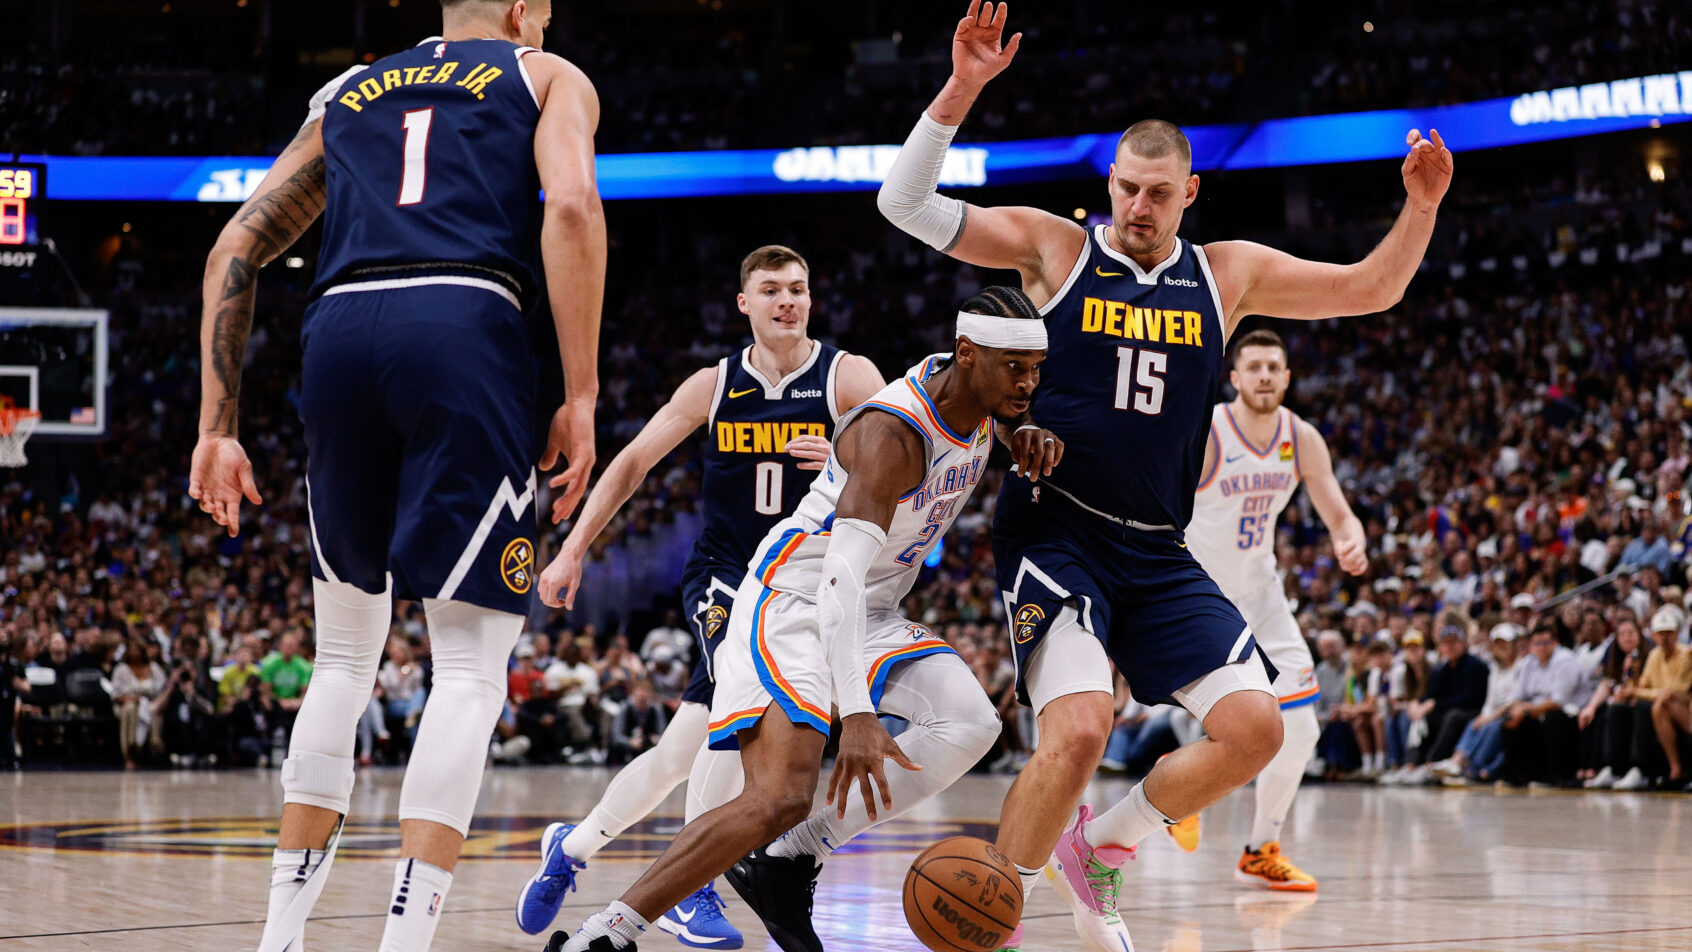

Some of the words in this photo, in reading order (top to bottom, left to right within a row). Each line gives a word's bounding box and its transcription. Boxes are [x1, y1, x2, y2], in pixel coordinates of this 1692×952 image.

[339, 61, 460, 112] PORTER
[455, 62, 503, 101] JR.
[396, 105, 434, 207] 1
[0, 169, 32, 199] 59
[1164, 275, 1198, 288] ibotta
[1081, 296, 1203, 347] DENVER
[791, 388, 822, 399] ibotta
[1114, 345, 1168, 415] 15
[755, 461, 783, 516] 0
[1243, 494, 1275, 513] CITY
[894, 521, 943, 568] 2
[1238, 512, 1270, 550] 55
[932, 894, 1001, 949] Wilson
